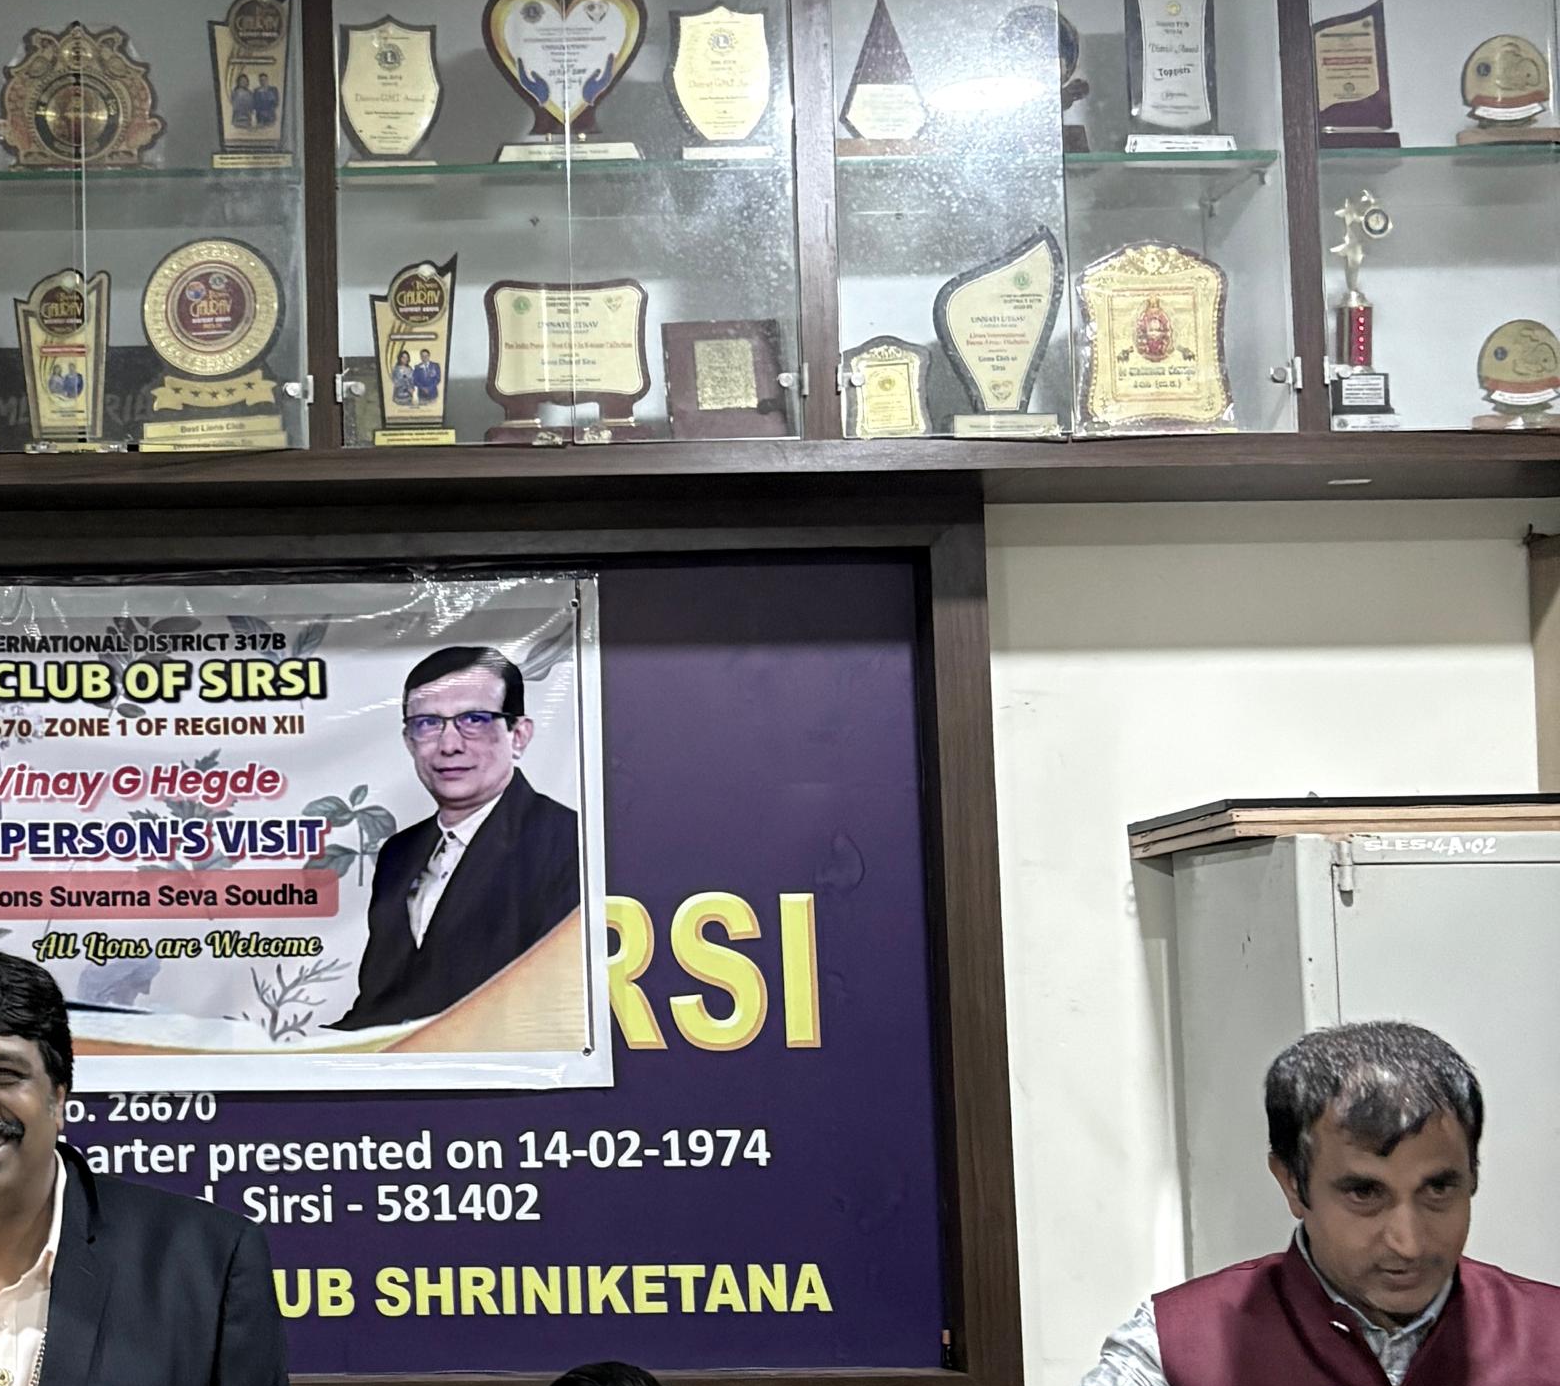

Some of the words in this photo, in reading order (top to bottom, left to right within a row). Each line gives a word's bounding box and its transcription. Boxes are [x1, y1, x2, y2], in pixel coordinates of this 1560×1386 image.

[133, 632, 230, 652] DISTRICT
[235, 632, 287, 651] 317B
[124, 659, 193, 703] OF
[199, 658, 328, 702] SIRSI
[43, 717, 110, 737] ZONE
[116, 717, 128, 736] 1
[135, 717, 167, 737] OF
[174, 716, 267, 736] REGION
[273, 715, 305, 735] XII
[111, 765, 142, 797] G
[149, 762, 282, 806] Hegde
[215, 818, 326, 855] VISIT
[49, 885, 151, 908] Suvarna
[157, 884, 218, 907] Seva
[224, 883, 319, 907] Soudha
[33, 931, 79, 961] All
[83, 930, 153, 966] Lions
[154, 937, 202, 959] are
[204, 929, 324, 959] Welcome
[64, 1099, 96, 1123] o.
[107, 1091, 217, 1122] 26670
[60, 1134, 196, 1175] arter
[208, 1129, 433, 1182] presented
[446, 1138, 504, 1170] on
[518, 1128, 772, 1169] 14-02-1974
[242, 1184, 334, 1225] Sirsi
[376, 1183, 541, 1223] 581402
[374, 1263, 833, 1318] SHRINIKETANA
